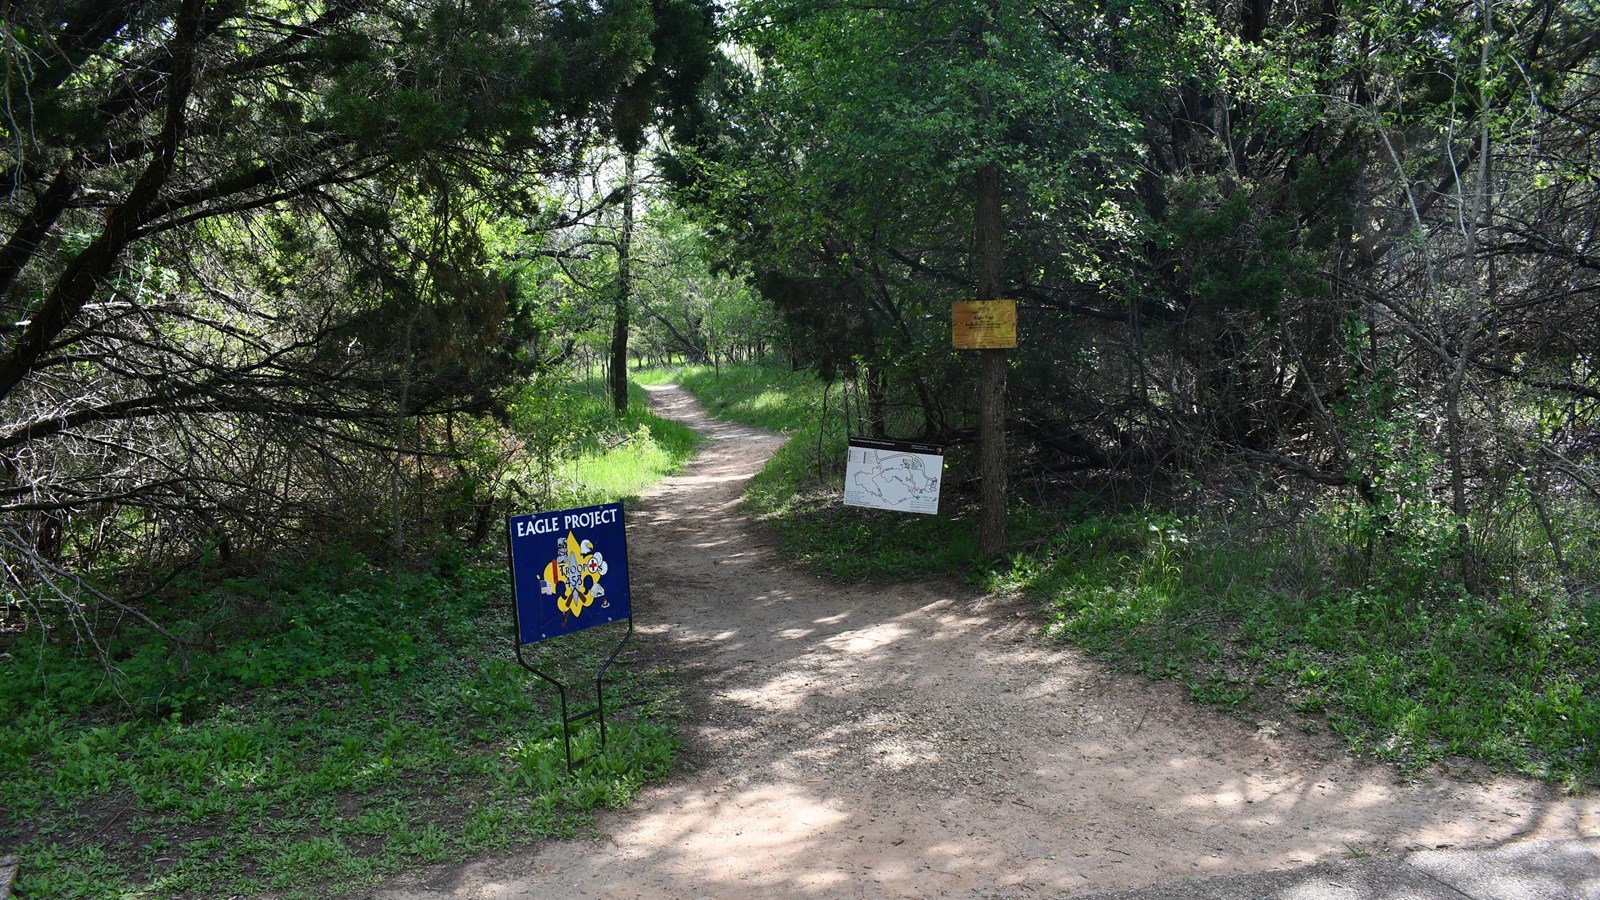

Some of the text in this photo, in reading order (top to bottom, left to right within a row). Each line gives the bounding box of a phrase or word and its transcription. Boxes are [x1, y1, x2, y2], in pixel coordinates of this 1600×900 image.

[517, 508, 617, 537] EAGLE PROJECT
[559, 563, 587, 576] TROOP
